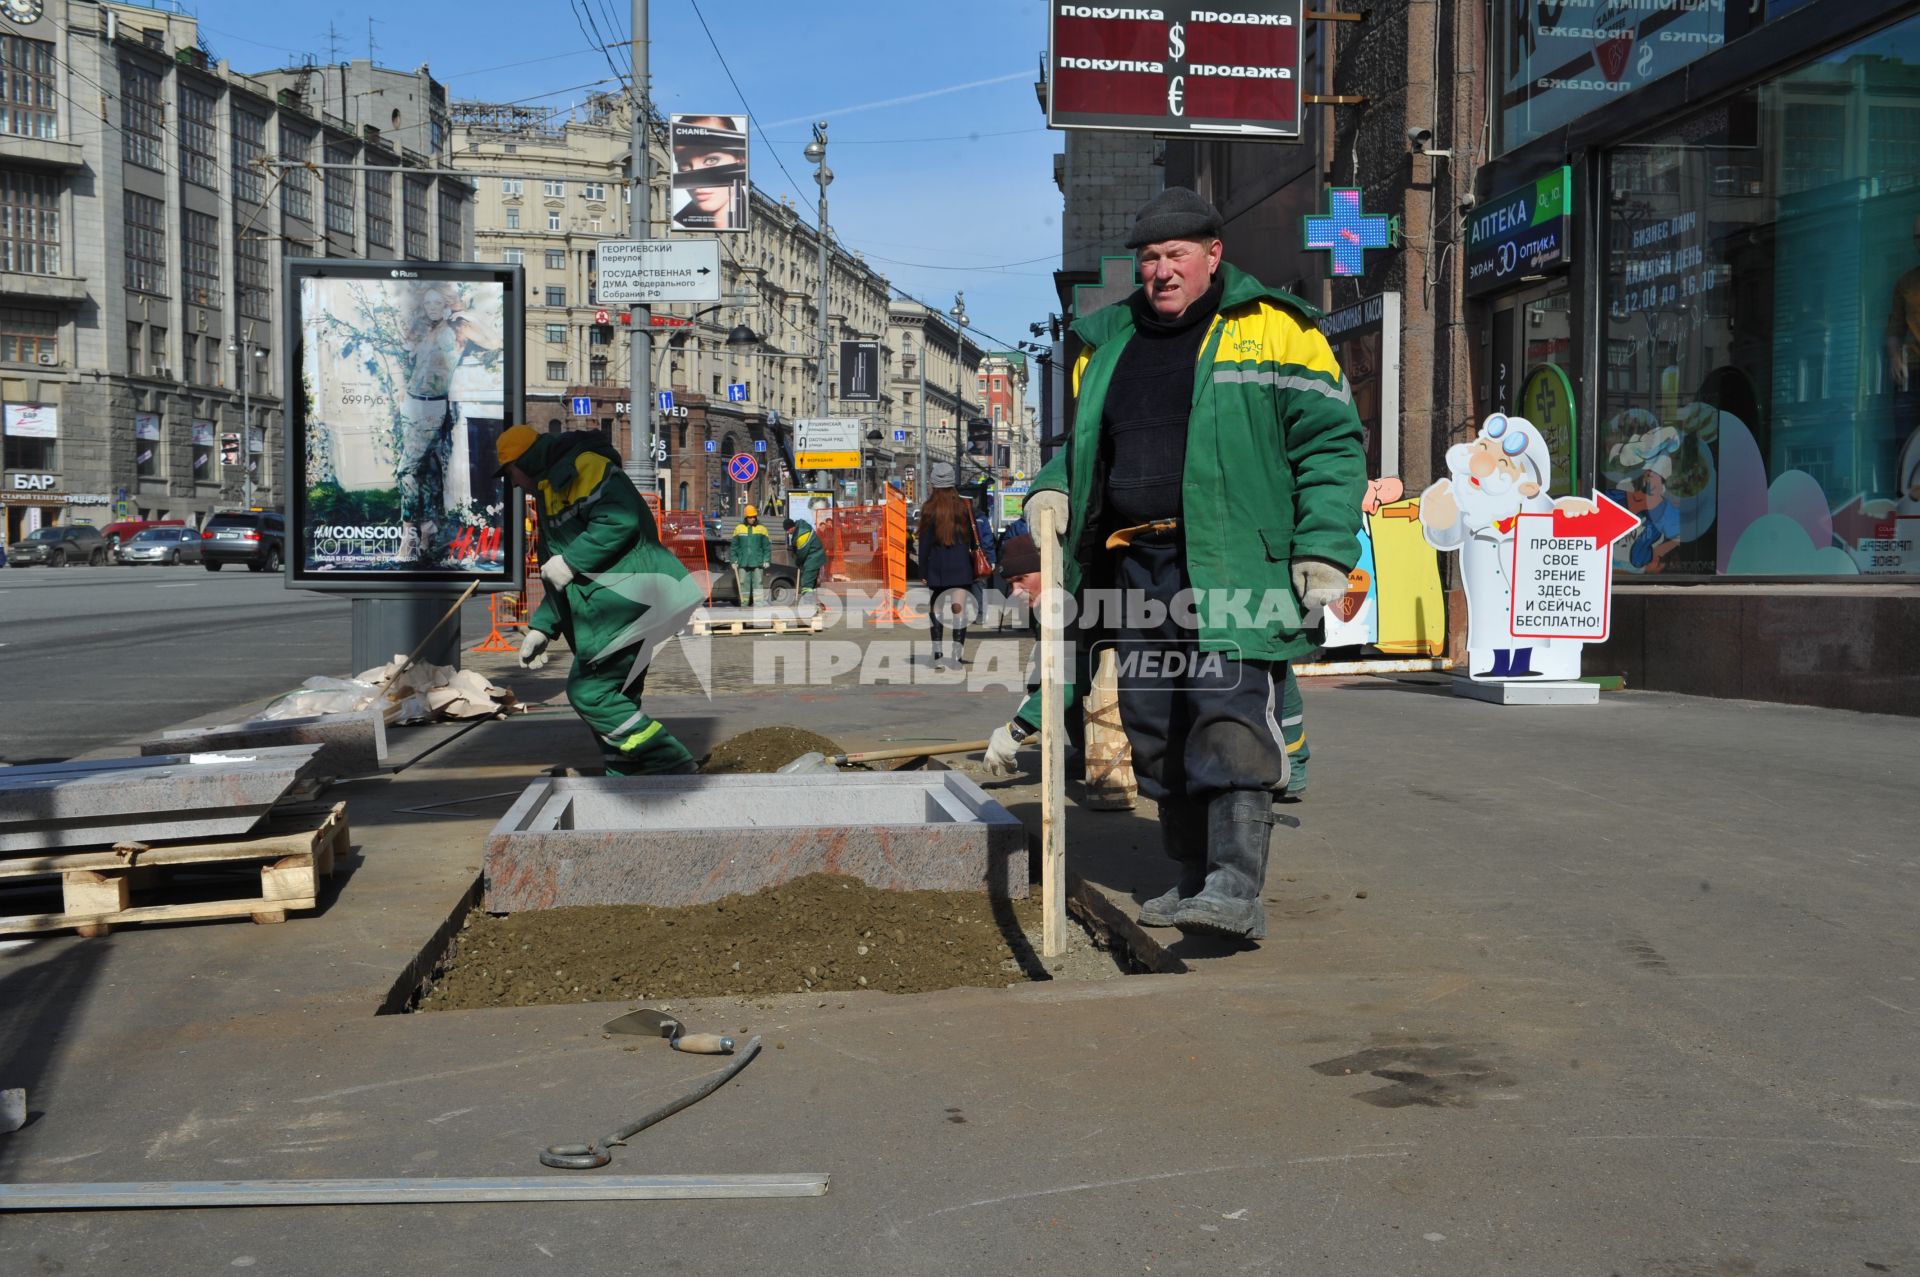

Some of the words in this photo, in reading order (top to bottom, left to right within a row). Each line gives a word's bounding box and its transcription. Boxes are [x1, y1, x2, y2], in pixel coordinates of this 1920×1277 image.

[1061, 5, 1164, 20] покупка
[1191, 11, 1292, 26] продажа
[1169, 22, 1185, 62] $
[1061, 57, 1163, 73] покупка
[1190, 64, 1291, 79] продажа
[1168, 75, 1184, 116] €
[1471, 199, 1527, 244] АПТЕКА
[1633, 221, 1668, 248] БИЗНЕС
[602, 245, 672, 253] ГЕОРГИЕВСКИЙ
[602, 255, 642, 263] переулок
[1470, 259, 1494, 279] ЭКРАН
[1519, 235, 1555, 258] ОПТИКА
[1675, 244, 1703, 274] ДЕНЬ
[602, 269, 691, 278] ГОСУДАРСТВЕННАЯ
[632, 280, 696, 288] Федерального
[602, 291, 645, 299] Собрания
[1364, 296, 1384, 324] КАССА
[342, 395, 362, 405] 699
[615, 402, 689, 418] REVED
[14, 474, 55, 490] БАР
[333, 526, 418, 539] CONSCIOUS
[1530, 538, 1593, 550] ПРОВЕРЬ
[1543, 555, 1579, 566] СВОЕ
[1534, 570, 1586, 581] ЗРЕНИЕ
[1538, 585, 1581, 598] ЗДЕСЬ
[1526, 601, 1534, 611] И
[1538, 599, 1592, 612] СЕЙЧАС
[1516, 616, 1600, 627] БЕСПЛАТНО!
